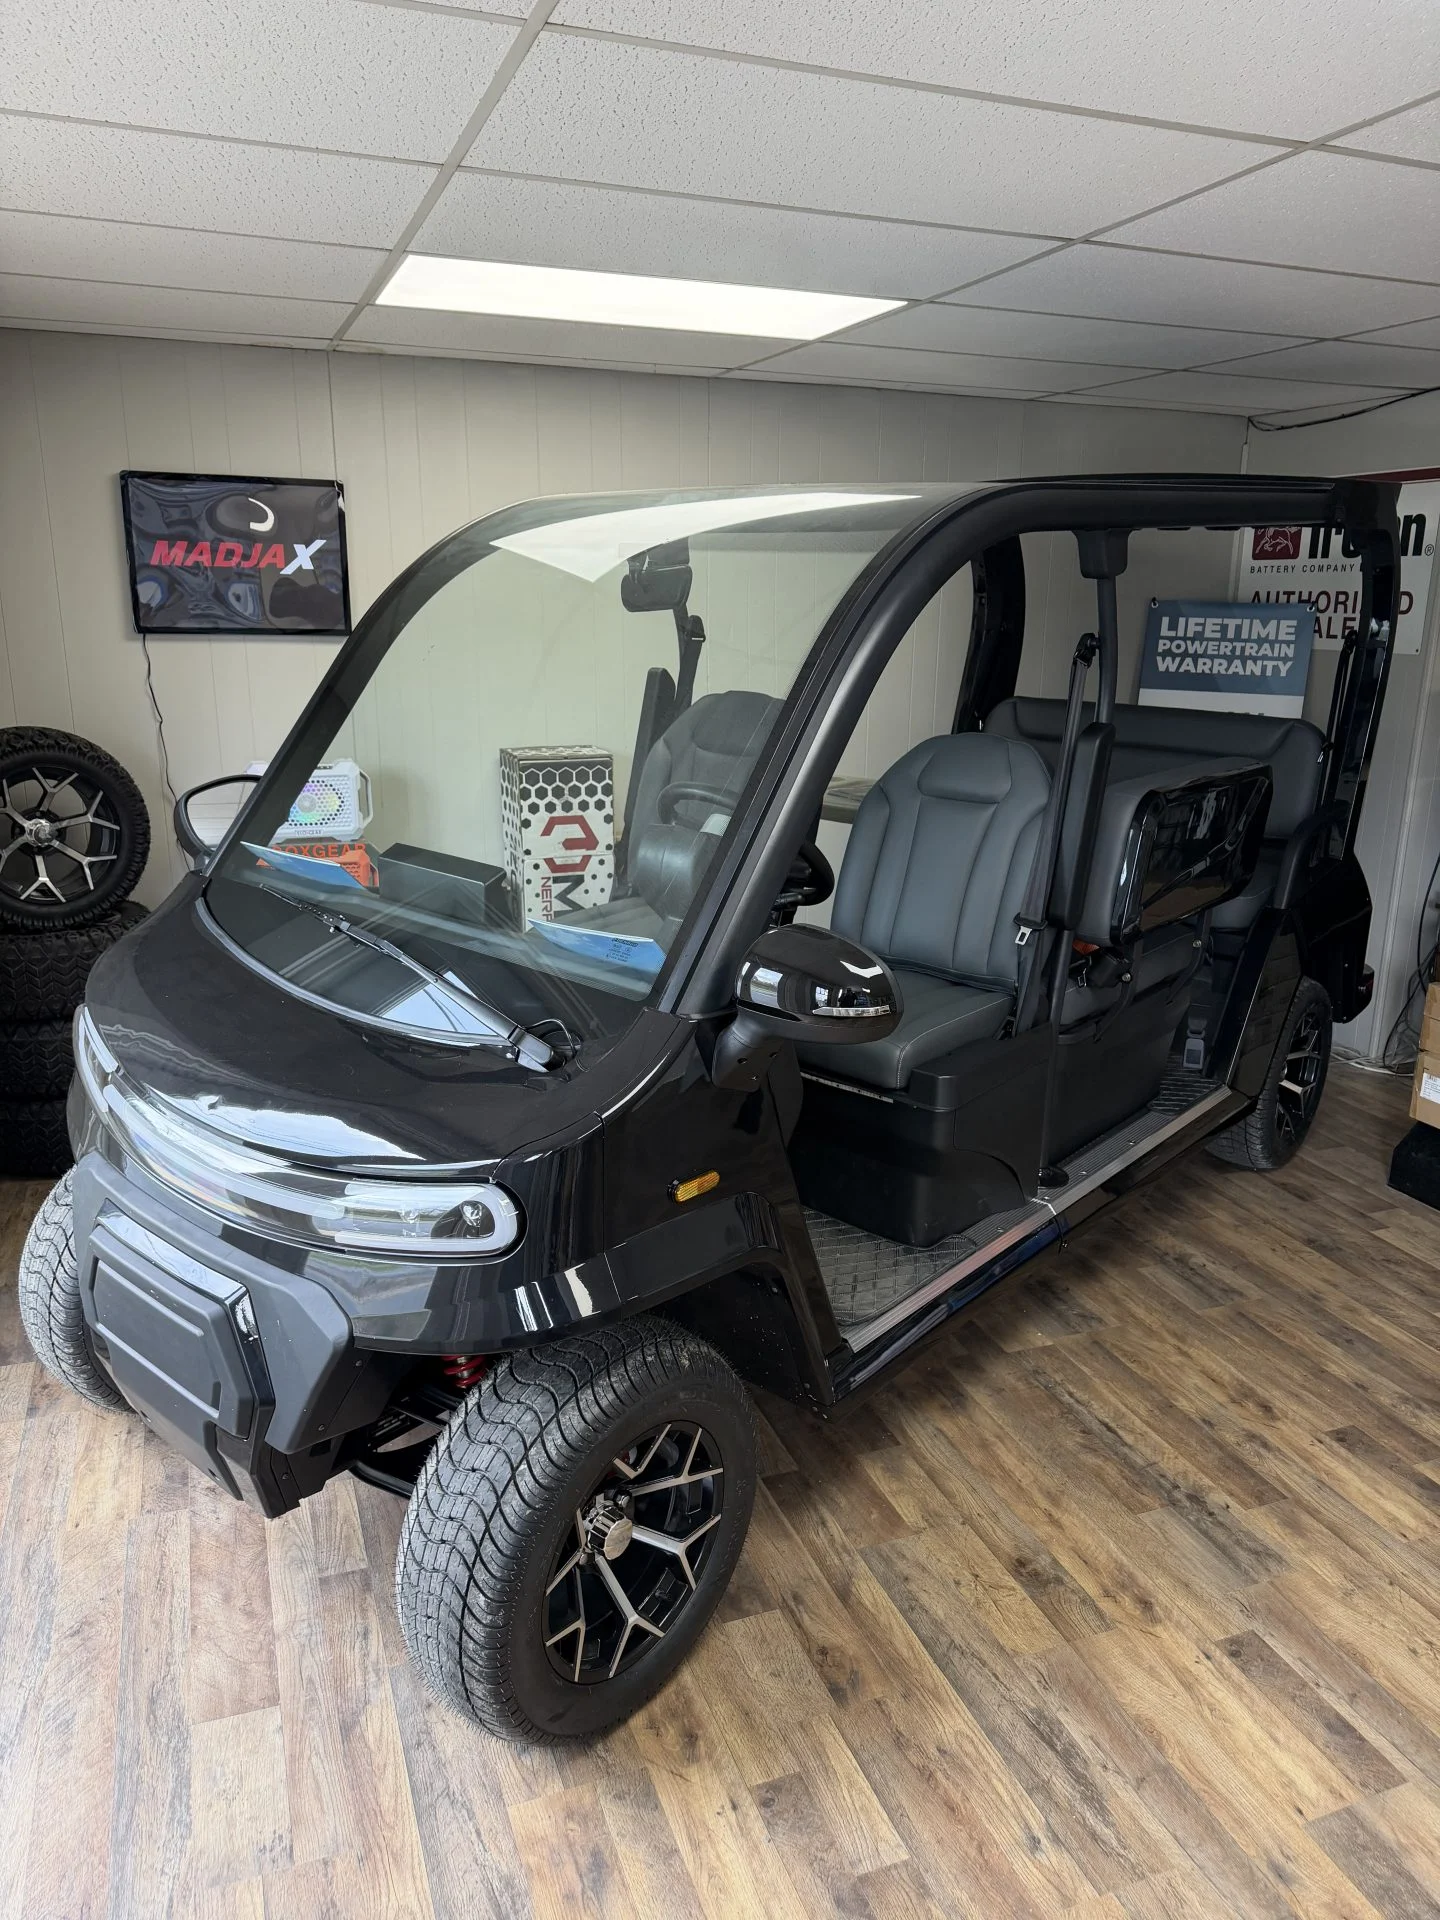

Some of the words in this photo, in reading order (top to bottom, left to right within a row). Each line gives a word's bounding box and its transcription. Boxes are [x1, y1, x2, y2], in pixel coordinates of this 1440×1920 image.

[150, 539, 326, 575] MADJAX
[1250, 565, 1296, 574] BATTERY
[1302, 563, 1355, 573] COMPANY
[1251, 590, 1414, 615] AUTHORID
[1159, 616, 1298, 641] LIFETIME
[1157, 639, 1295, 658] POWERTRAIN
[1156, 656, 1293, 677] WARRANTY
